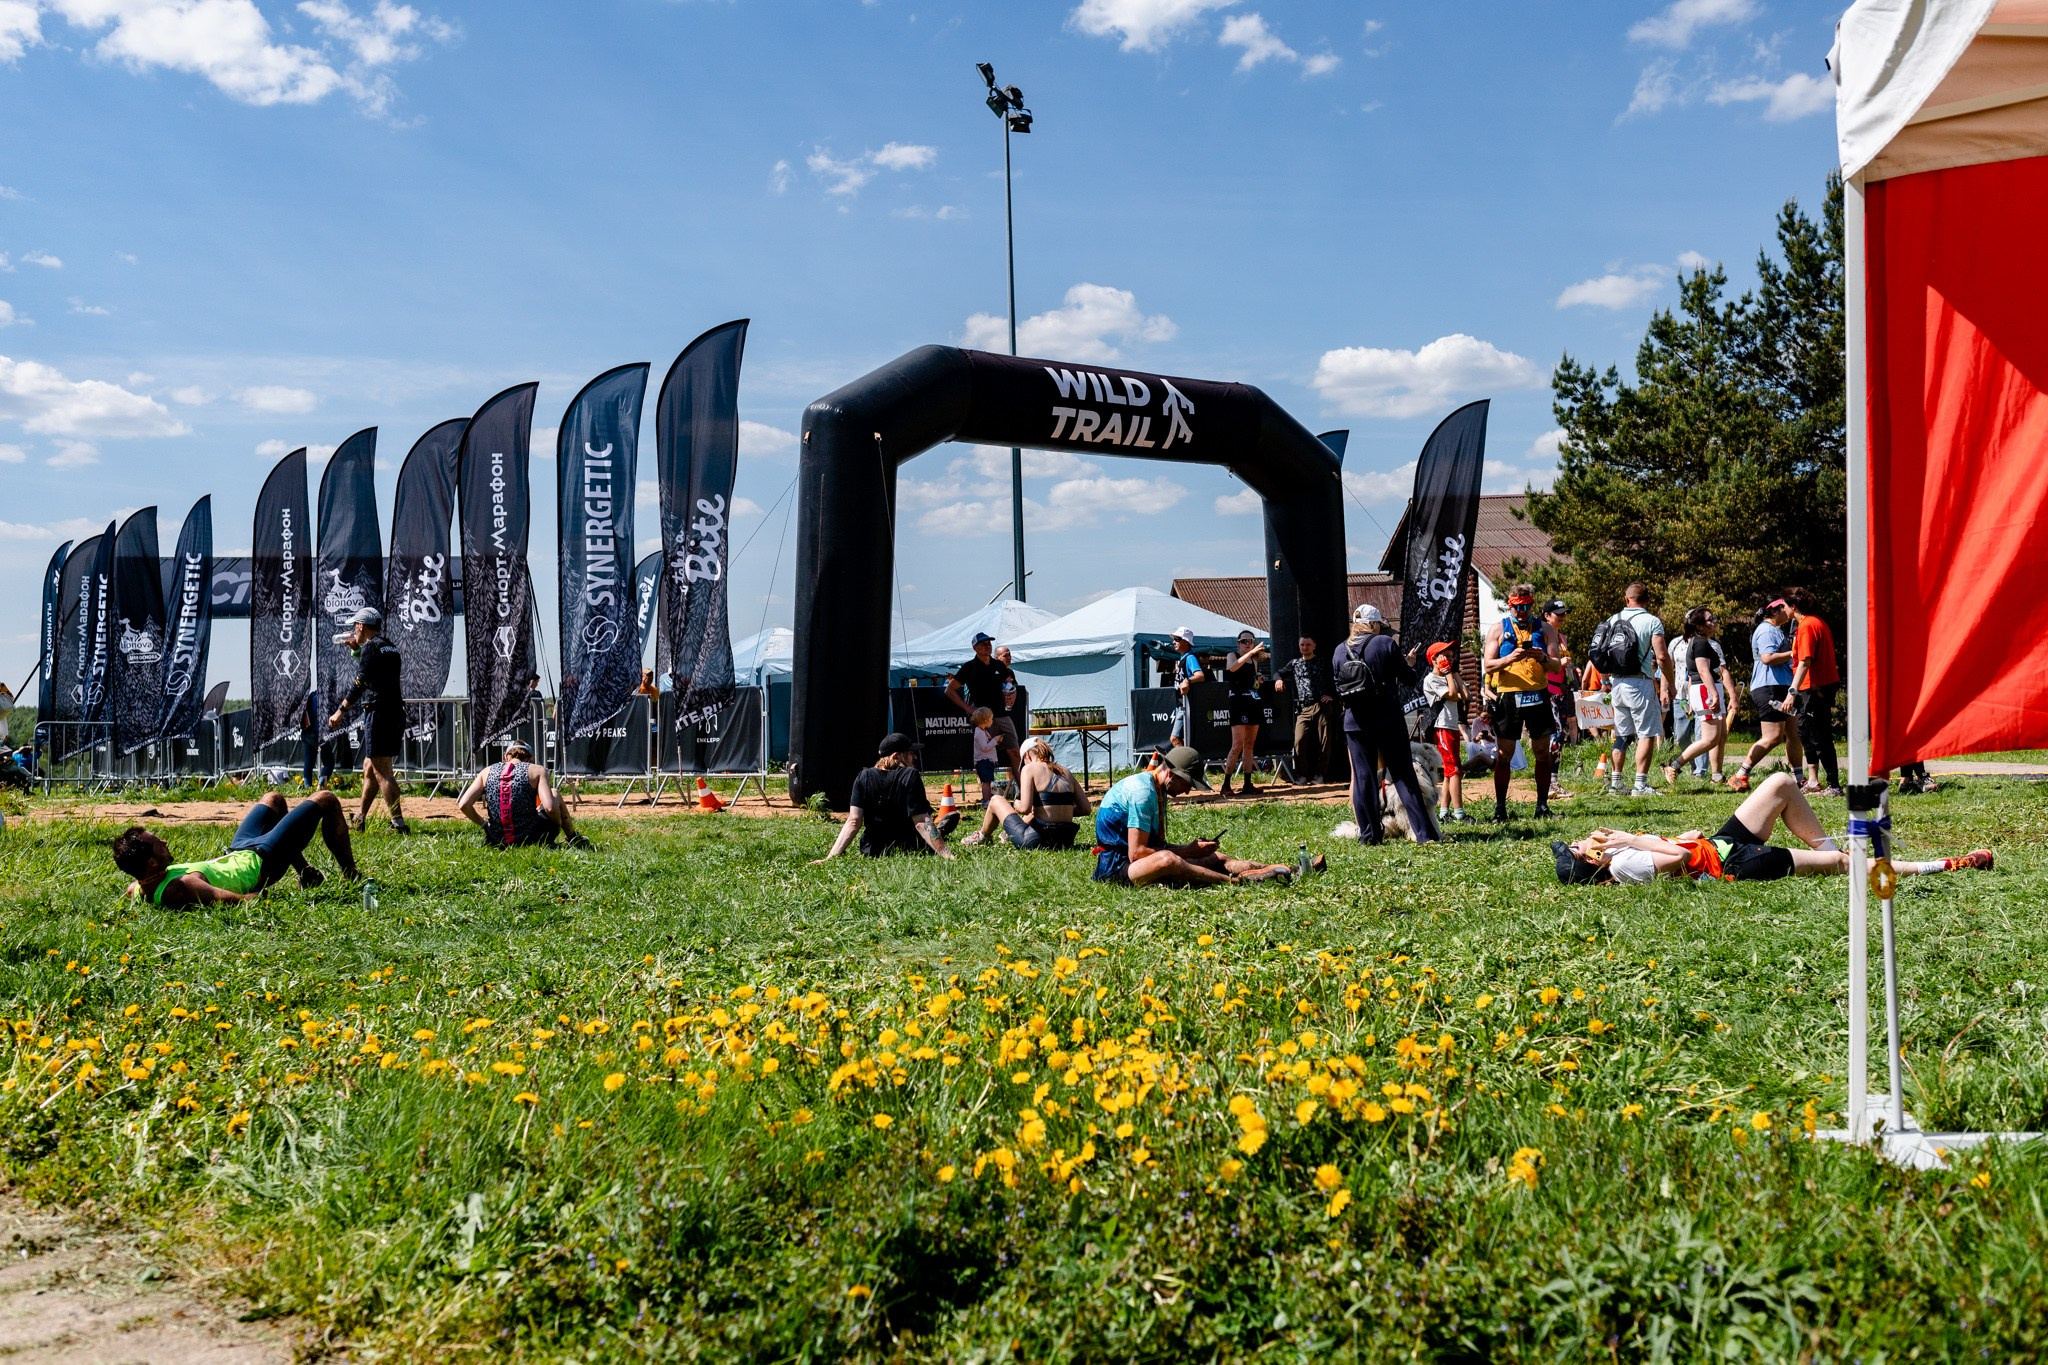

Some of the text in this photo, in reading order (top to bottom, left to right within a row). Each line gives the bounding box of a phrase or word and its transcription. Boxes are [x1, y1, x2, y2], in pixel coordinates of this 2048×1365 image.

[1044, 366, 1151, 407] WILD
[1050, 406, 1156, 448] TRAIL
[584, 441, 614, 606] SYNERGETIC
[684, 493, 725, 583] Bite
[1416, 569, 1429, 600] take
[1430, 533, 1466, 601] Bite
[325, 595, 365, 608] bionova
[410, 552, 445, 623] Bite
[174, 552, 202, 665] SYNERGETIC
[399, 591, 411, 622] take
[93, 573, 108, 677] SYNERGETIC
[1522, 694, 1540, 704] 1216
[602, 727, 627, 738] PEAKS
[925, 716, 970, 728] NATURAL
[925, 727, 957, 737] premium
[1152, 713, 1169, 722] TWO
